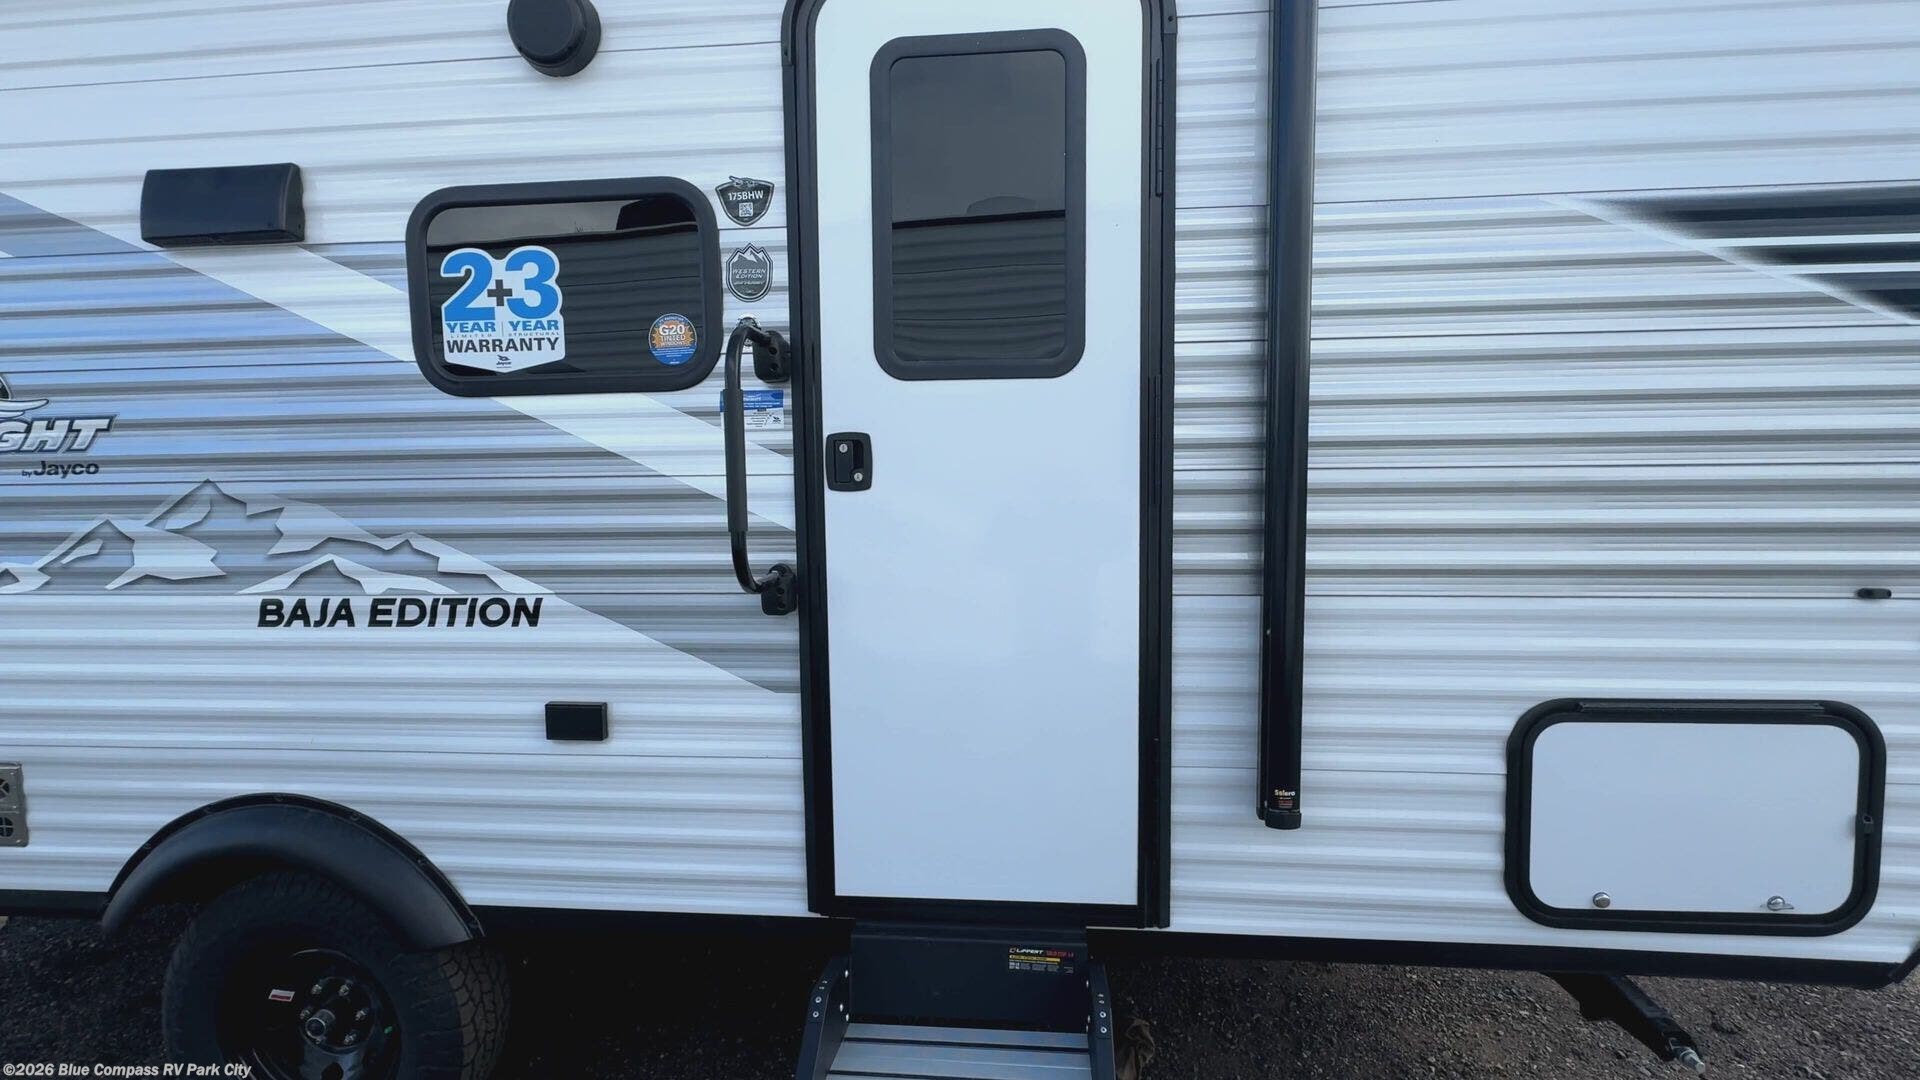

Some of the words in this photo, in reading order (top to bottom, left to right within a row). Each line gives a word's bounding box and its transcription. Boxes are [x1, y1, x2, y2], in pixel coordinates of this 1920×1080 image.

[728, 190, 764, 201] 175BHW
[445, 321, 496, 333] YEAR
[508, 320, 560, 332] YEAR
[659, 324, 686, 336] G20
[446, 337, 560, 354] WARRANTY
[22, 470, 33, 478] by
[34, 460, 100, 479] Jayco
[257, 598, 355, 628] BAJA
[367, 597, 544, 628] EDITION
